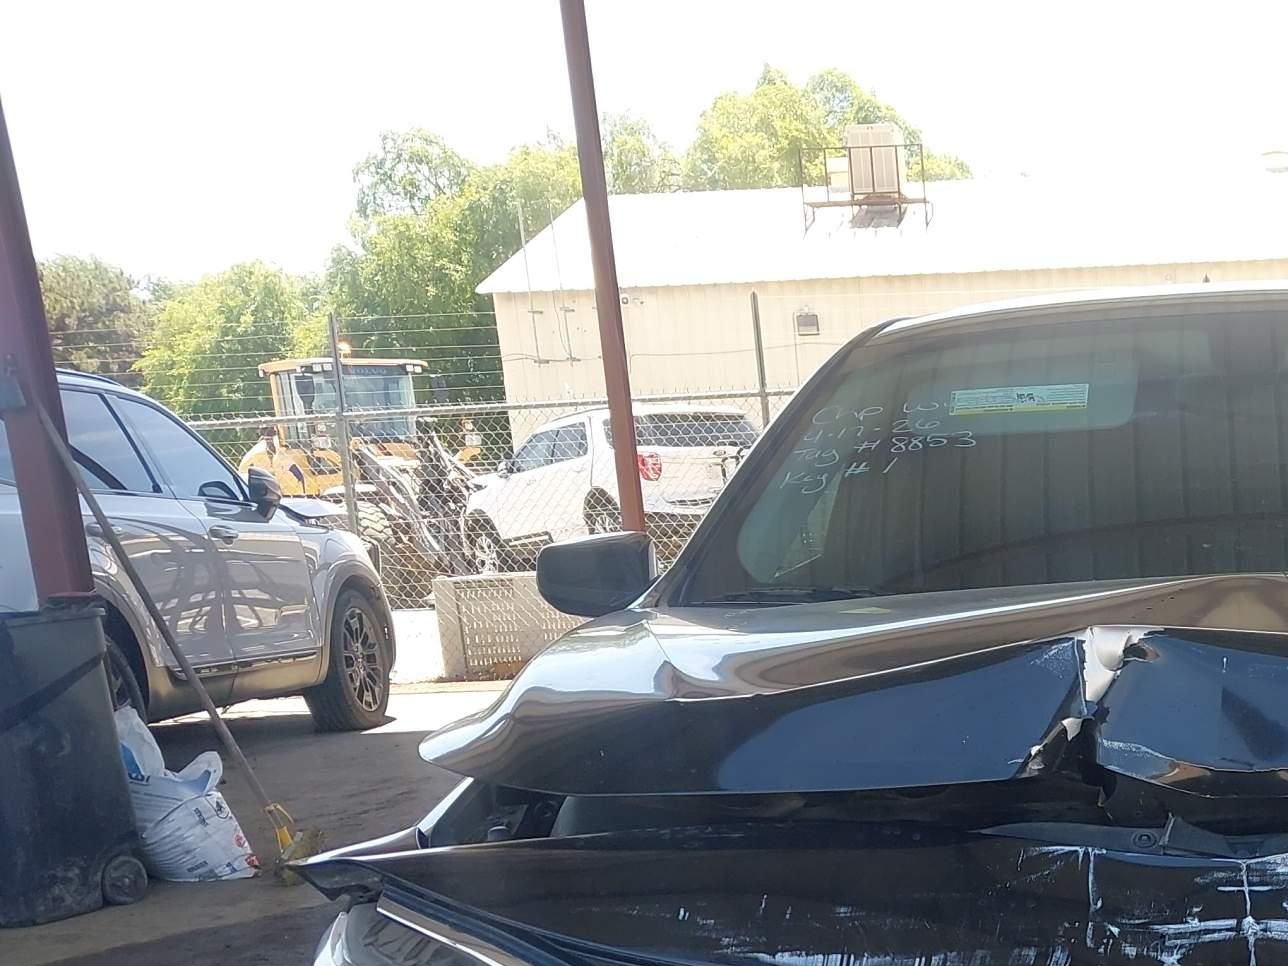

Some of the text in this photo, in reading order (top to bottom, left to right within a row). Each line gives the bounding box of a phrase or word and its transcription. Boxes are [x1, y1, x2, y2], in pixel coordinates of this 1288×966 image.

[890, 430, 977, 453] 8853
[780, 471, 828, 494] Key
[844, 461, 871, 478] #
